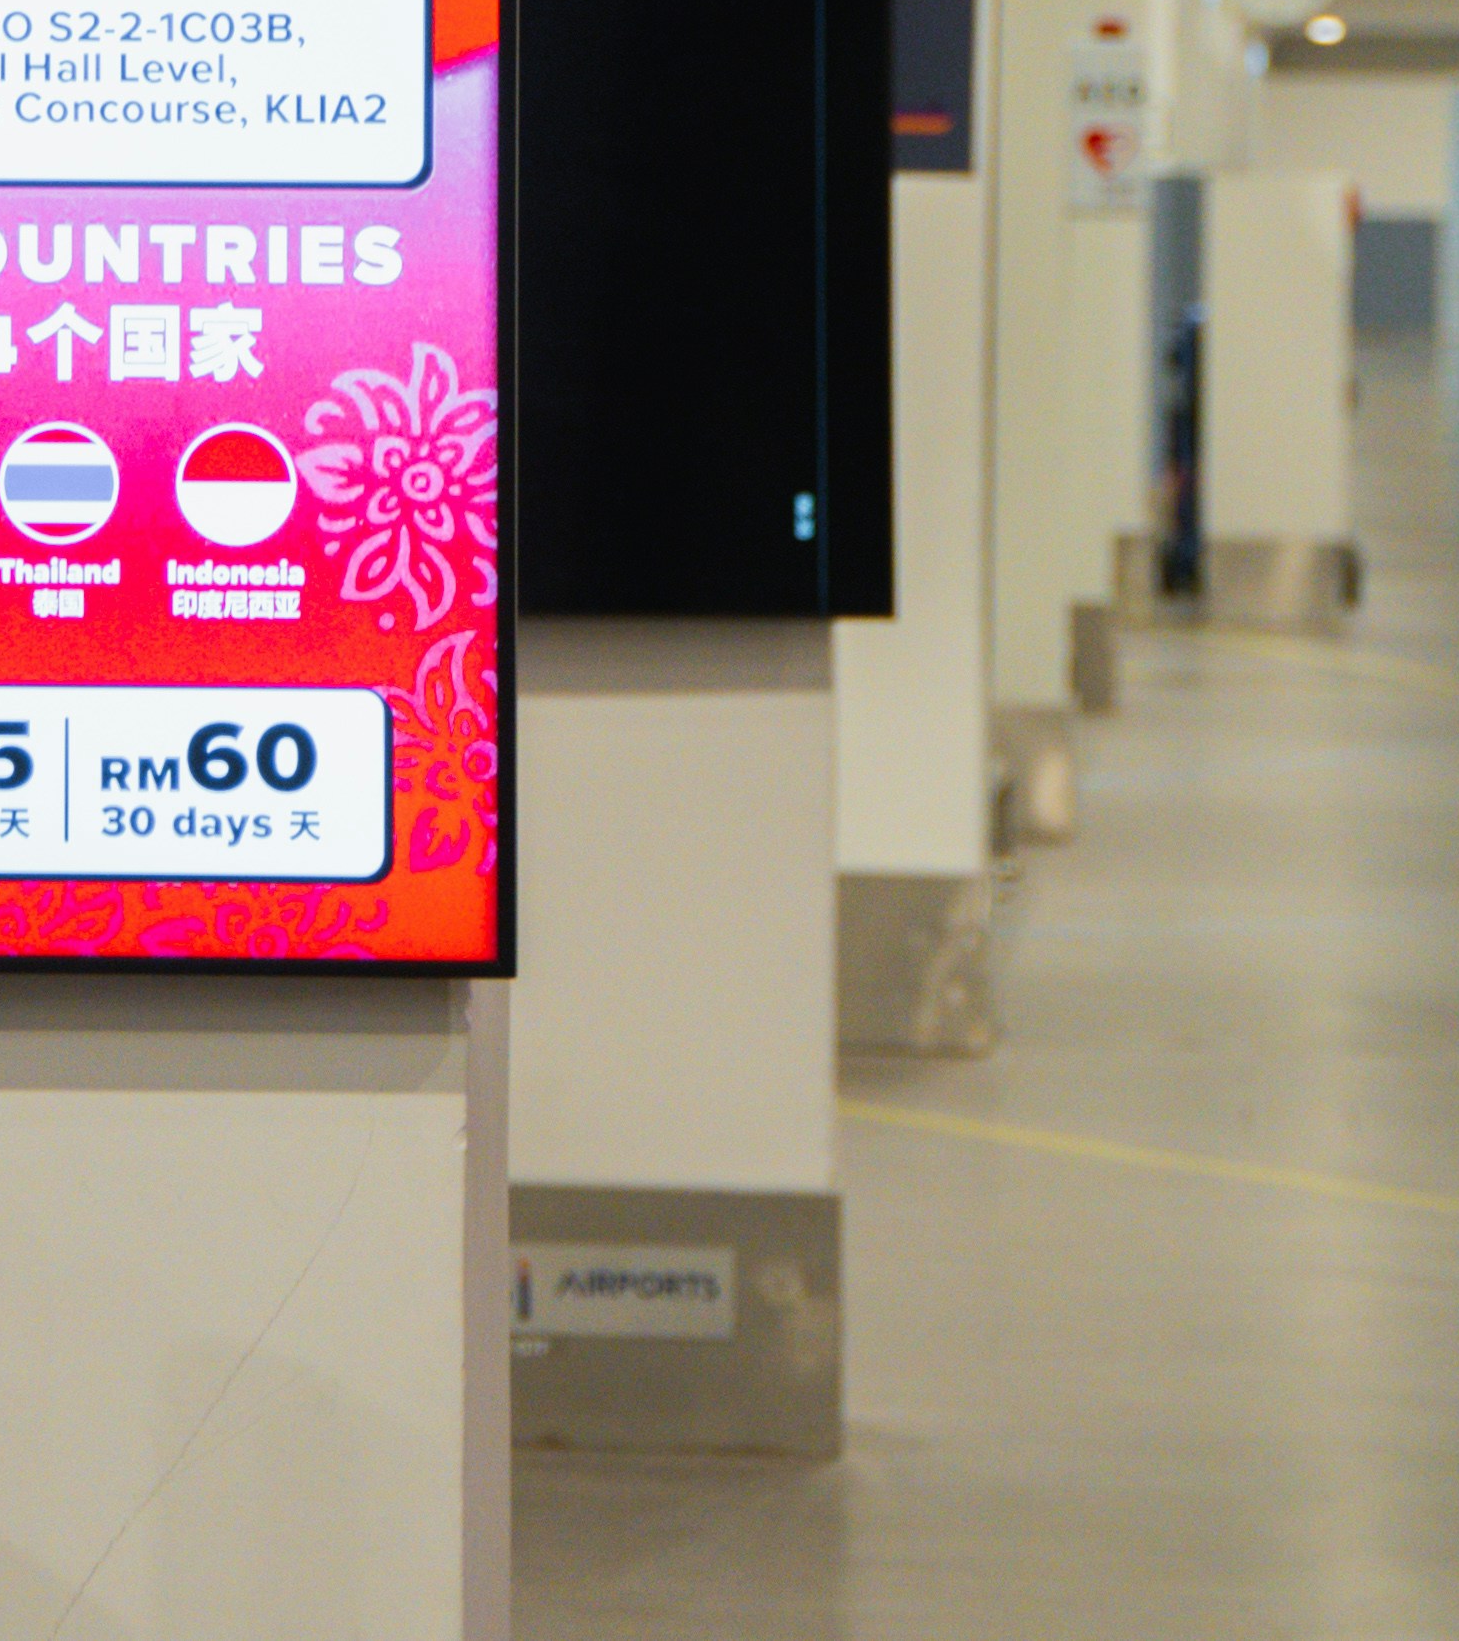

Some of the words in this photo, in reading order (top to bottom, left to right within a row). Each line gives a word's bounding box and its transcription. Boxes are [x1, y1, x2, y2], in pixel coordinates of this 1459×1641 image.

[48, 10, 306, 48] S2-2-1C03B,
[23, 52, 102, 84] Hall
[119, 52, 238, 88] Level,
[14, 91, 249, 129] Concourse,
[265, 92, 387, 125] KLIA2
[166, 557, 306, 587] Indonesia
[31, 587, 86, 619] 泰国
[171, 588, 302, 621] 印度尼西亚
[100, 804, 157, 838] 30
[171, 805, 274, 848] days
[289, 810, 321, 841] 天
